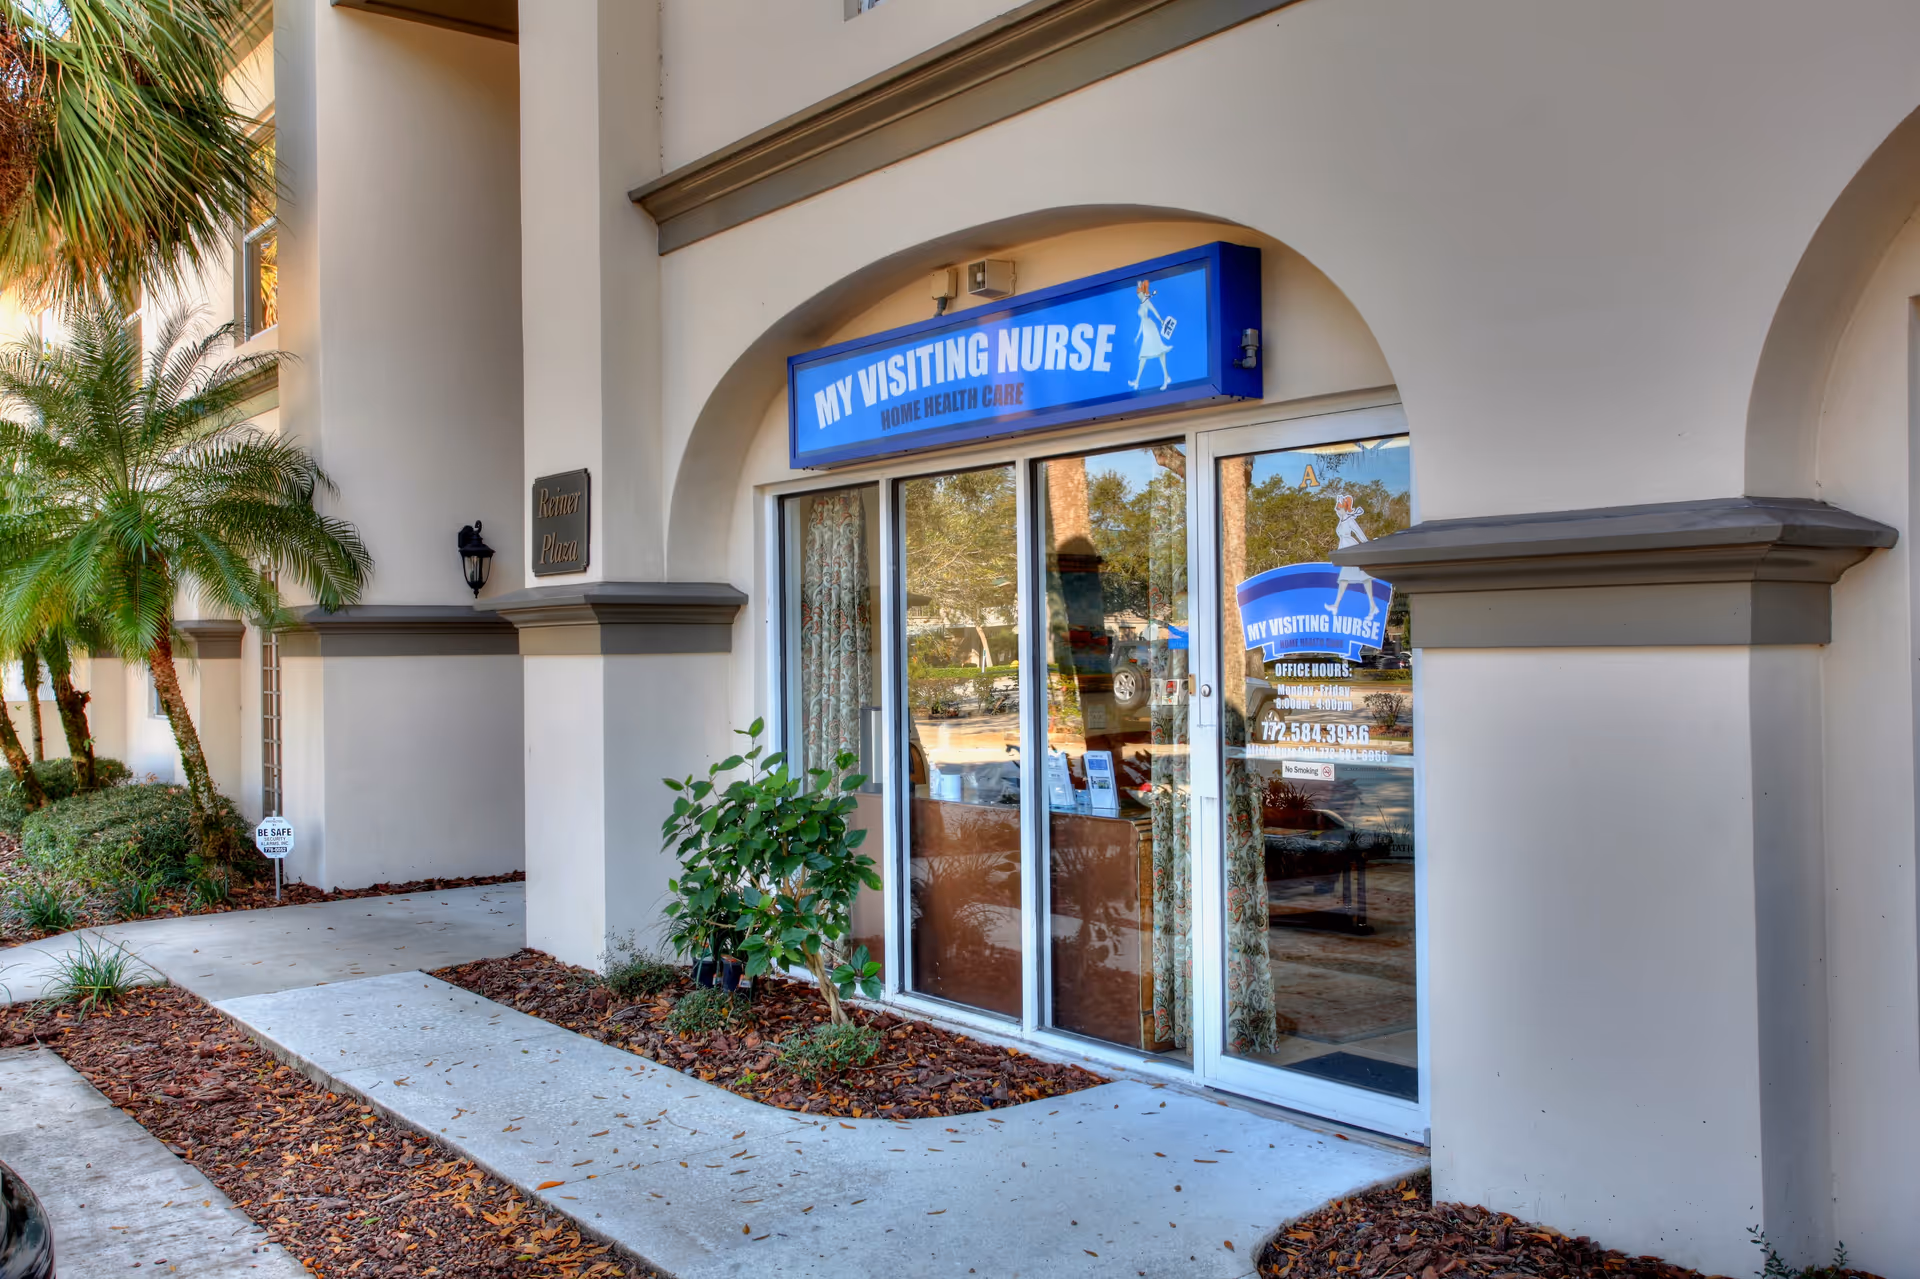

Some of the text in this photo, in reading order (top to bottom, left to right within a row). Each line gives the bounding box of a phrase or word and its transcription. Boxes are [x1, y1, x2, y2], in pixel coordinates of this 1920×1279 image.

[814, 323, 1117, 430] MY VISITING NURSE
[881, 382, 1025, 431] HOME HEALTH CARE
[1300, 464, 1320, 488] A
[537, 487, 581, 519] Reiner
[539, 532, 579, 564] Plaza
[1247, 614, 1381, 642] MY VISITING NURSE
[1275, 662, 1353, 678] OFFICE HOURS:
[1277, 683, 1315, 696] Monday
[1320, 684, 1351, 697] Friday
[1316, 698, 1353, 711] 4:00pm
[1261, 721, 1370, 745] 772.584.3936
[1285, 765, 1318, 776] No Smoking
[258, 828, 292, 837] BE SAFE
